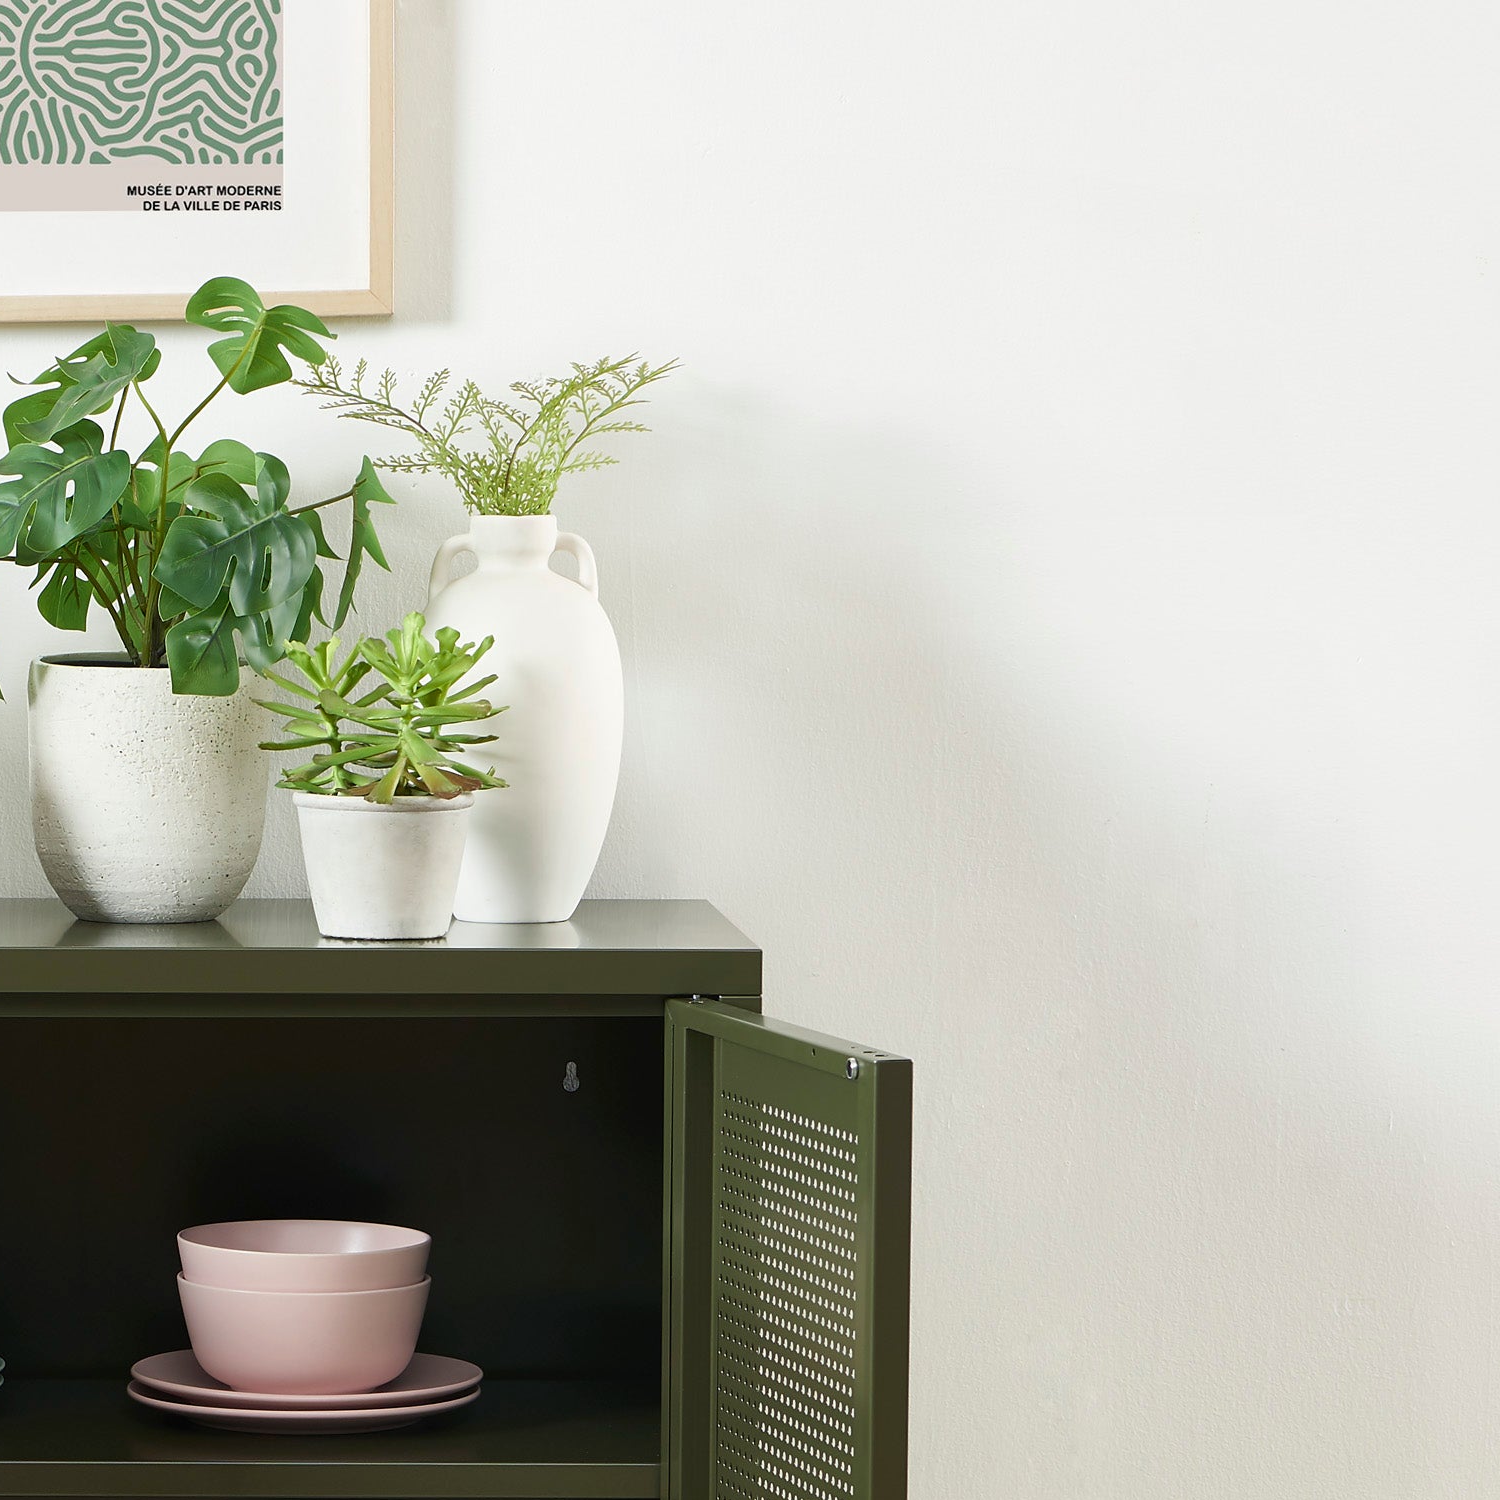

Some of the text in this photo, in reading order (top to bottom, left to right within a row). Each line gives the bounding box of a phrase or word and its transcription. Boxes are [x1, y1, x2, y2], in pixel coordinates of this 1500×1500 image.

[126, 183, 282, 196] MUSÉE D'ART MODERNE
[142, 200, 282, 211] DE LA VILLE DE PARIS
